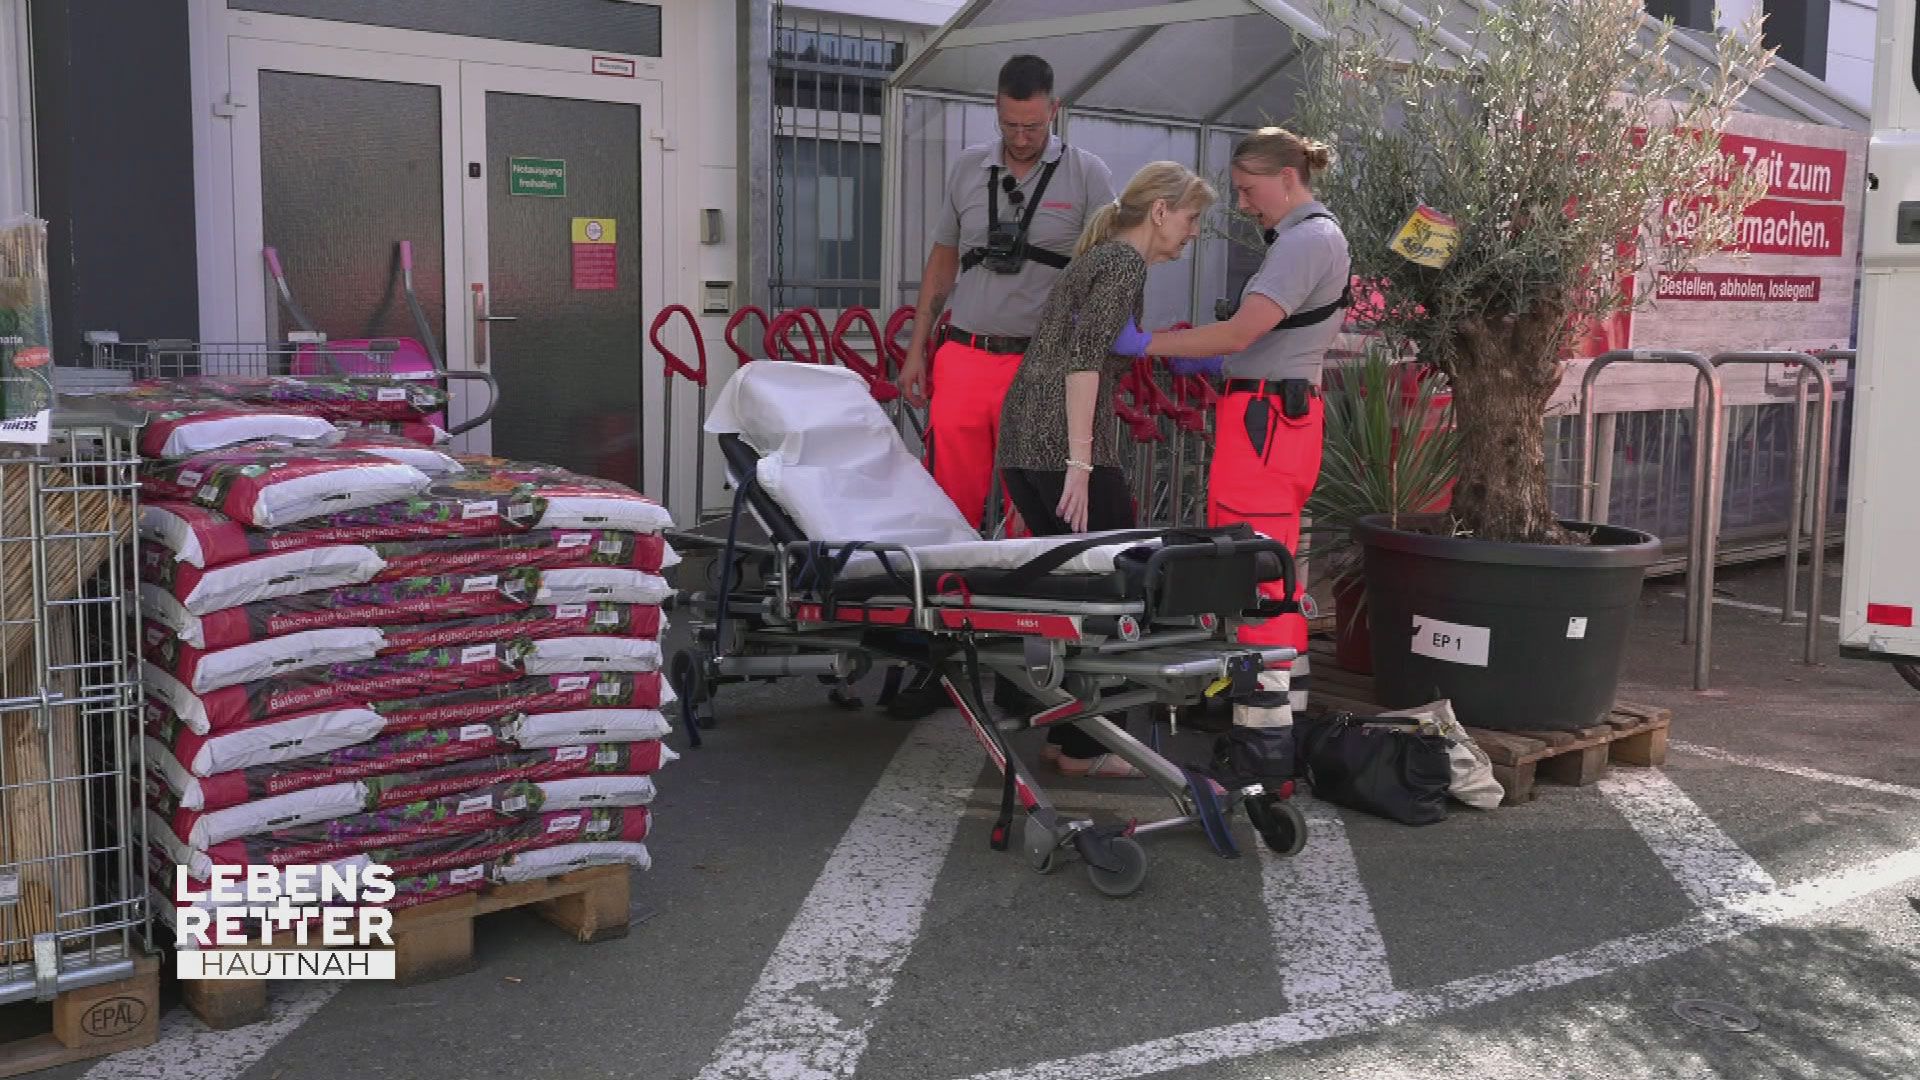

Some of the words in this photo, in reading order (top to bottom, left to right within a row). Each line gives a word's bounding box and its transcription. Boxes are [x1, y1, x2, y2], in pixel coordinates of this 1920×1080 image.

[512, 164, 563, 178] Notausgang
[1741, 145, 1784, 188] Zeit
[1787, 161, 1832, 194] zum
[1659, 274, 1717, 299] Bestellen,
[1719, 276, 1766, 299] abholen,
[1768, 278, 1815, 301] loslegen!
[1432, 632, 1450, 648] EP
[1455, 638, 1462, 651] 1
[91, 1003, 138, 1032] EPAL
